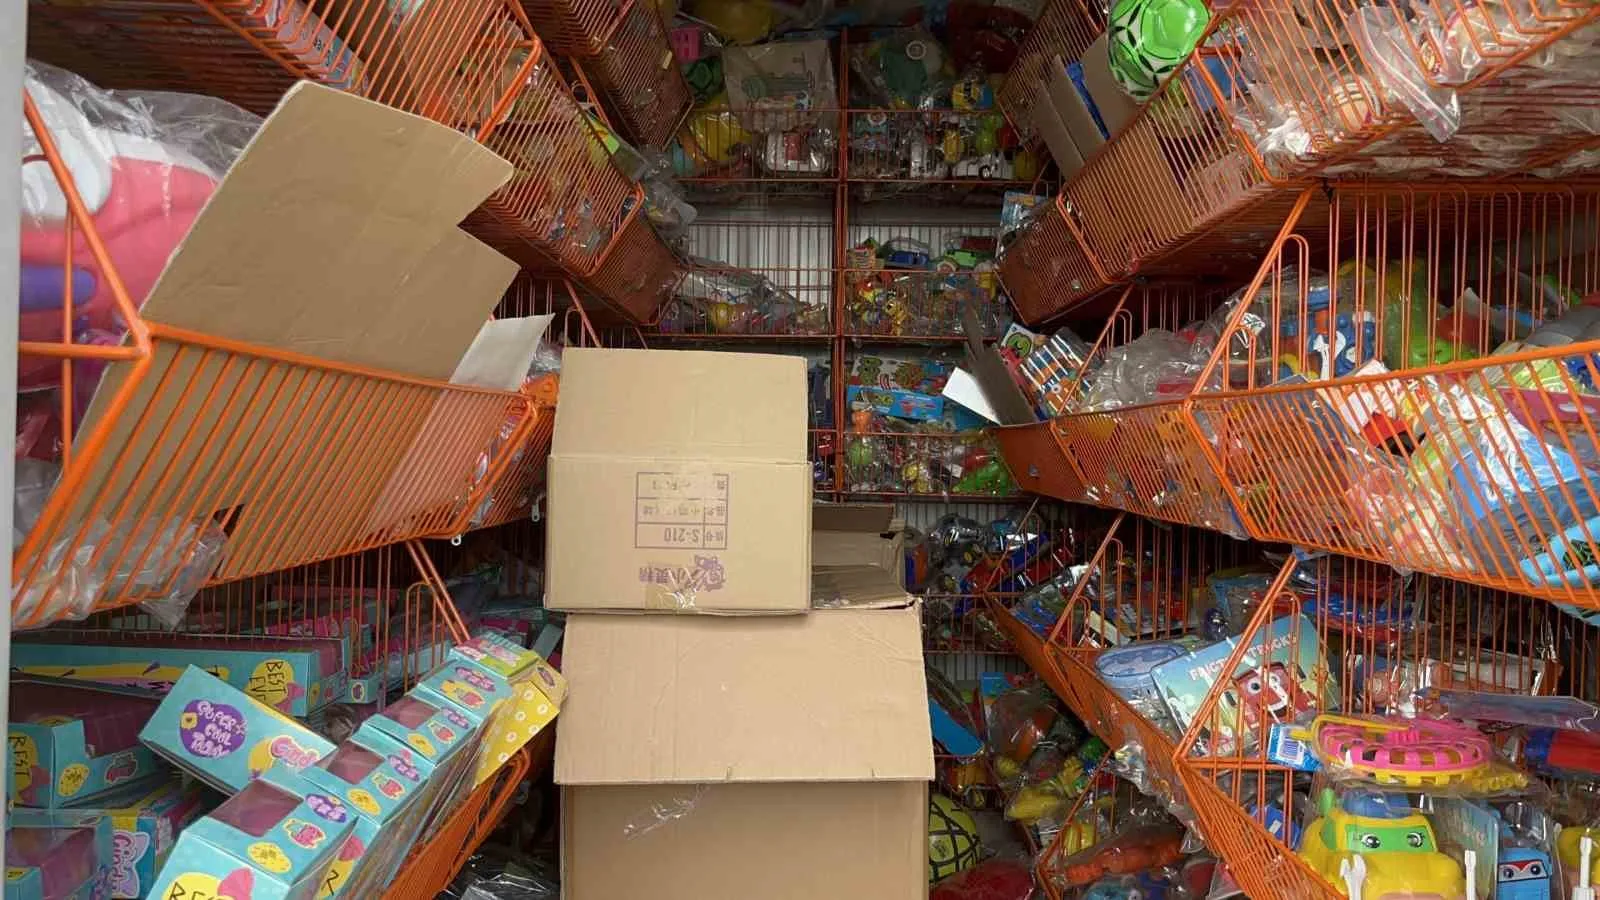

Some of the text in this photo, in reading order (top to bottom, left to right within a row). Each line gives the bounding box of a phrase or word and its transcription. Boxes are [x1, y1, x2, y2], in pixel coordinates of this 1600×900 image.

[664, 527, 700, 543] S-210
[266, 661, 288, 694] BEST
[197, 699, 236, 732] SUPER
[204, 722, 232, 746] COOL
